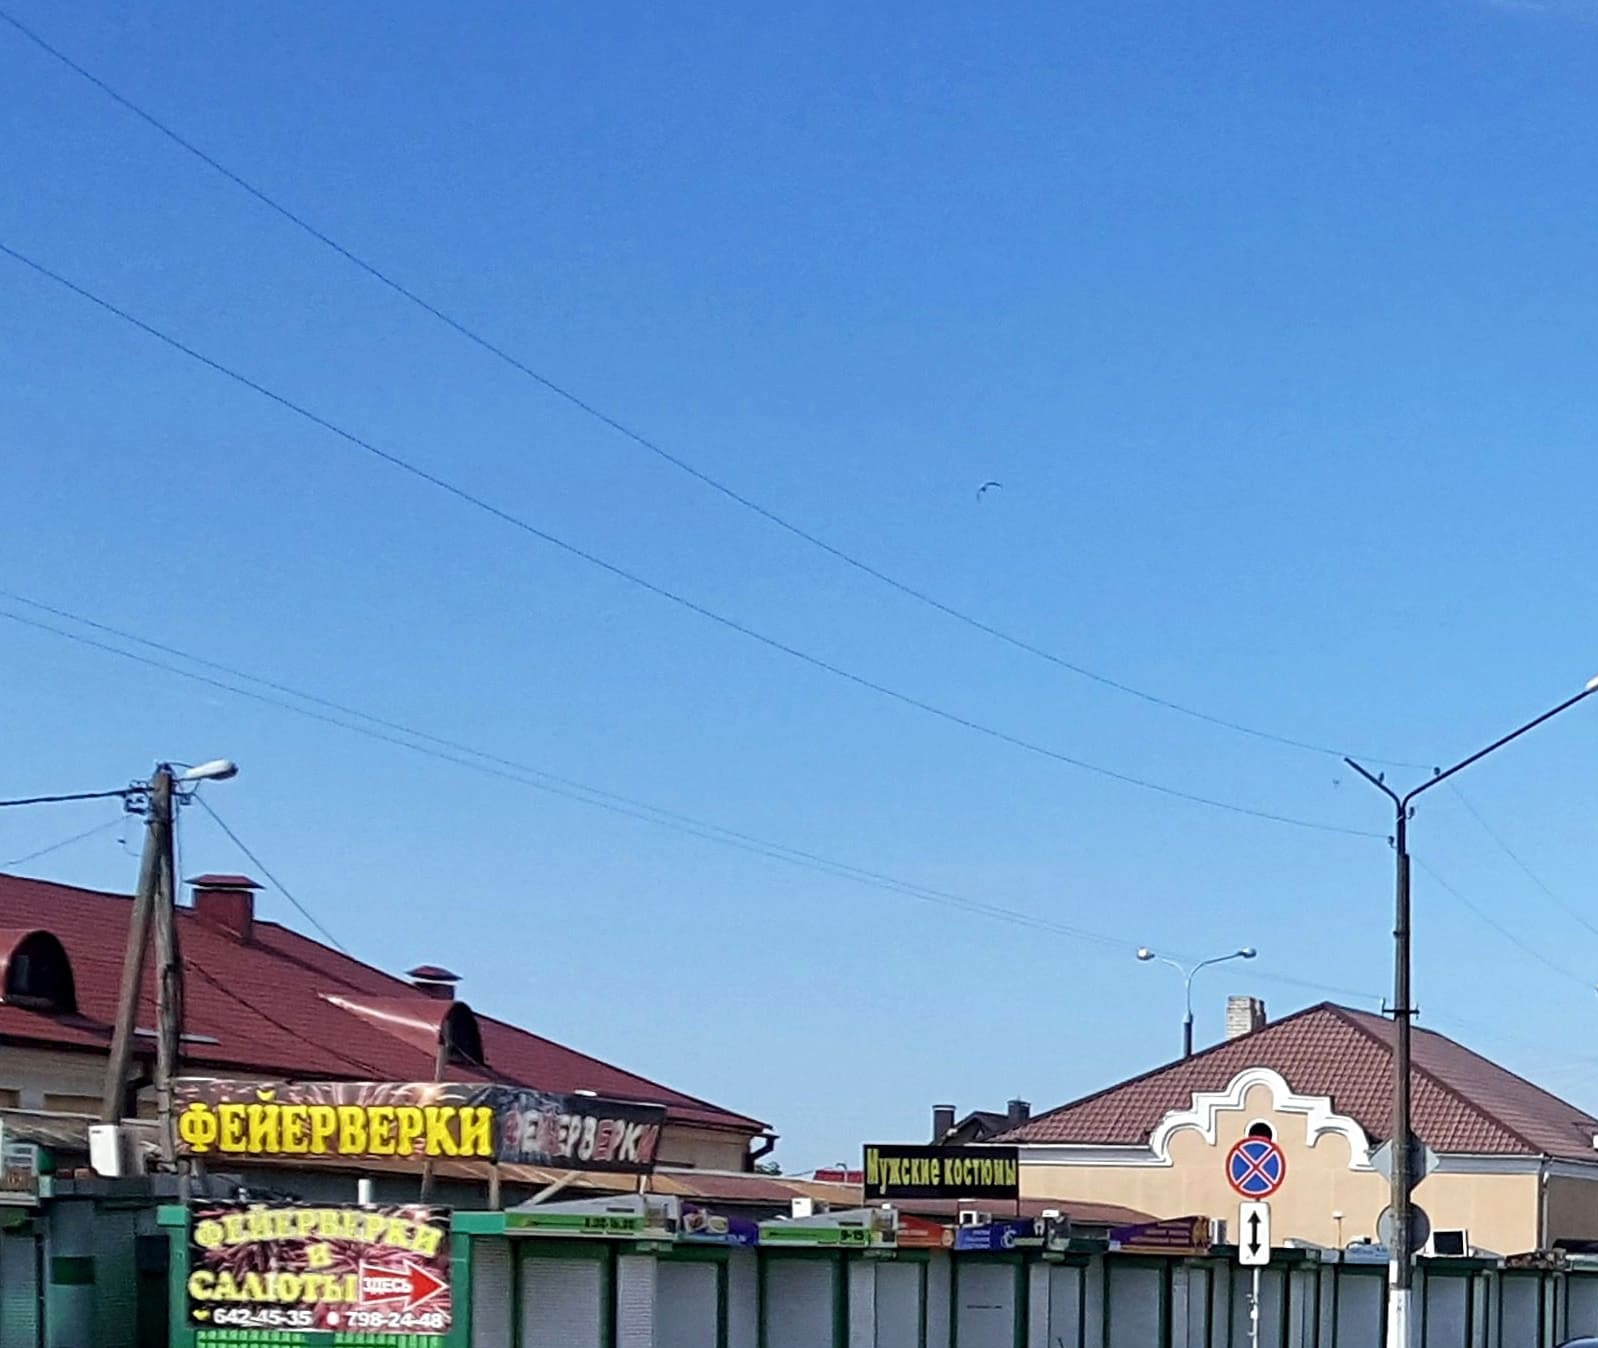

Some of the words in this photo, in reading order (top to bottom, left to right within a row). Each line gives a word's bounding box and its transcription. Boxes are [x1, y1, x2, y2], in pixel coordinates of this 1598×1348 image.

[180, 1089, 494, 1156] ФЕЙЕРВЕРКИ
[503, 1102, 660, 1164] ФЕЙЕРВЕРКИ
[867, 1148, 941, 1194] Мужские
[944, 1156, 1017, 1187] костюмы
[193, 1205, 444, 1258] ФЕЙЕРВЕРКИ
[188, 1270, 358, 1303] САЛЮТЫ
[362, 1276, 412, 1296] ЗДЕСЬ
[213, 1309, 314, 1325] 642-45-35
[346, 1311, 444, 1327] 798-24-48
